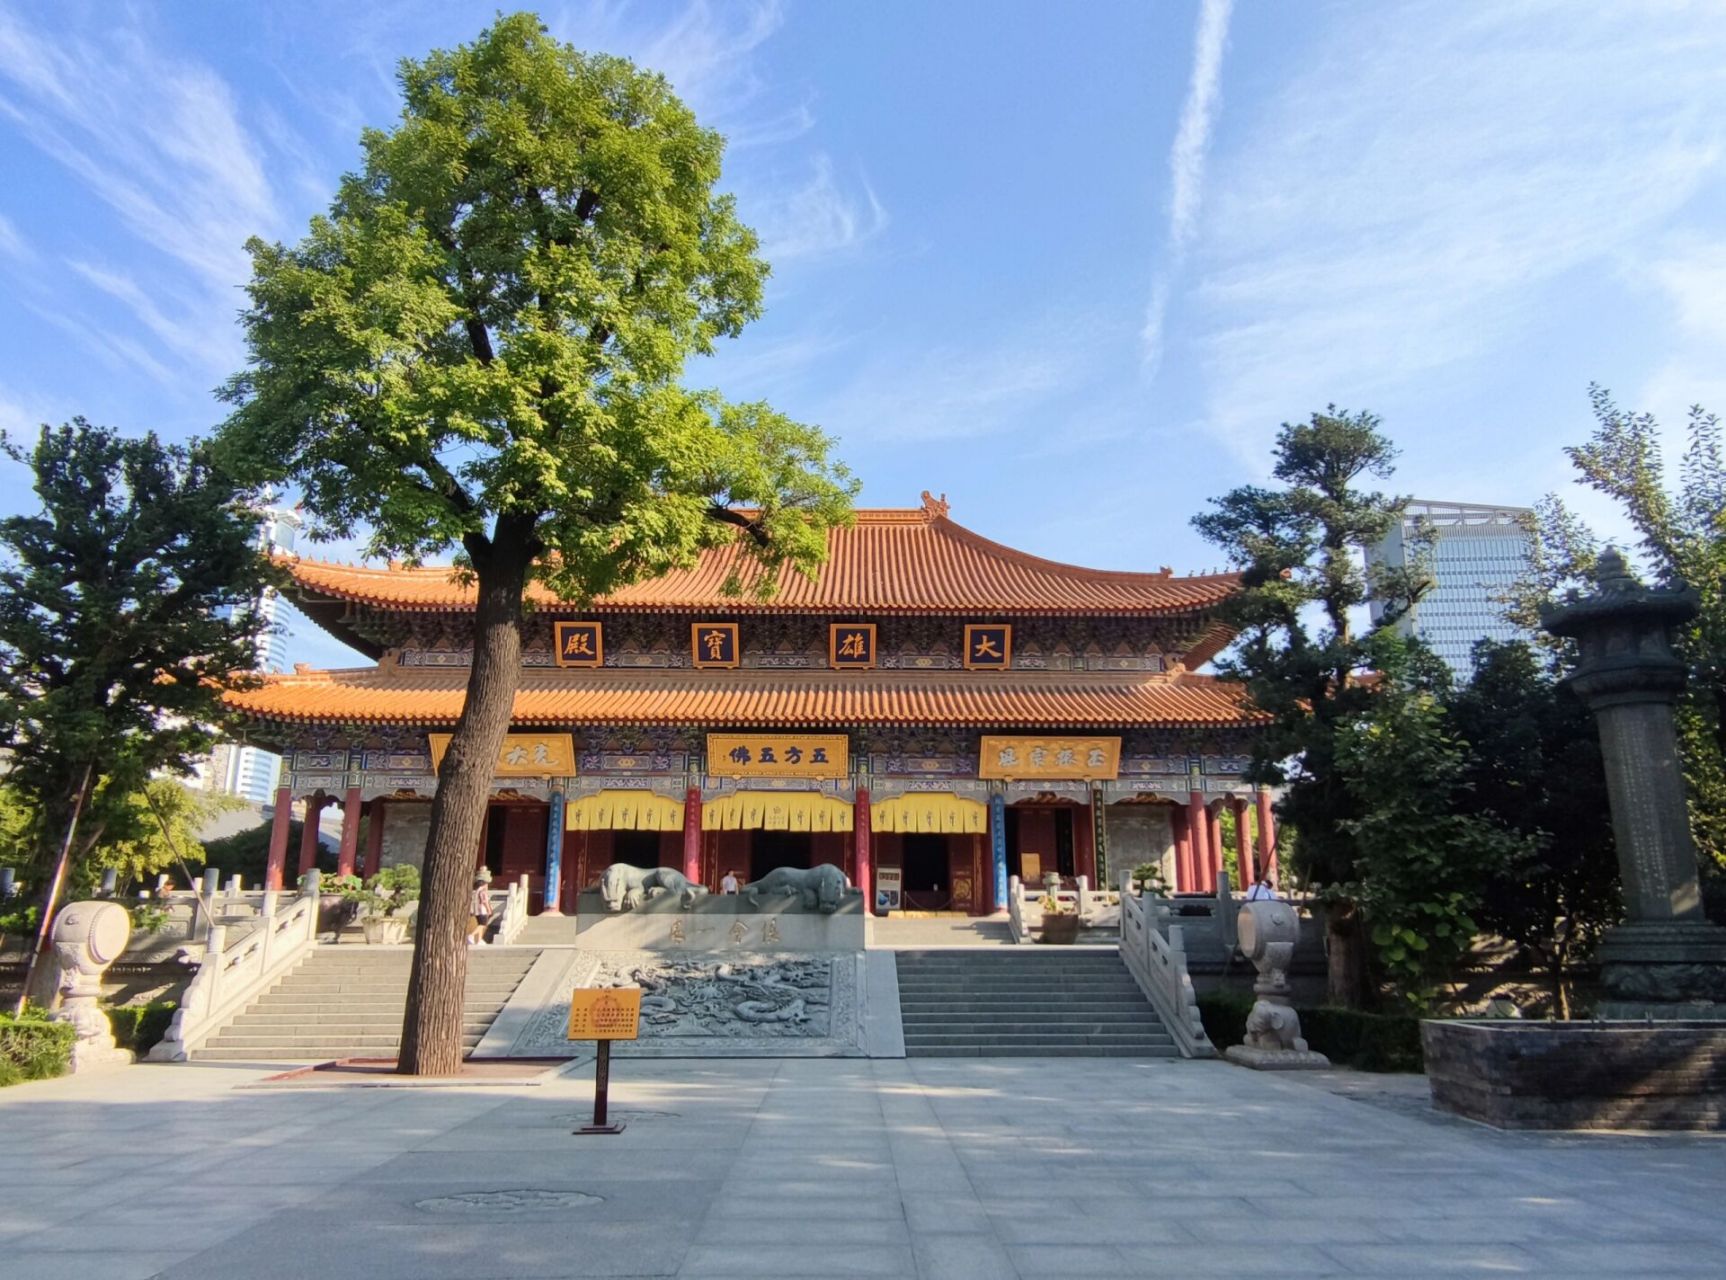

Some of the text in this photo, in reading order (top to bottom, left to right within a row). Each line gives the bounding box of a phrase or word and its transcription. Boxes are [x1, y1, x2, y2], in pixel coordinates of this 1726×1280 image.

[563, 632, 595, 655] 殿
[838, 633, 866, 657] 雄
[974, 635, 1003, 657] 大
[728, 745, 829, 766] 五方五佛
